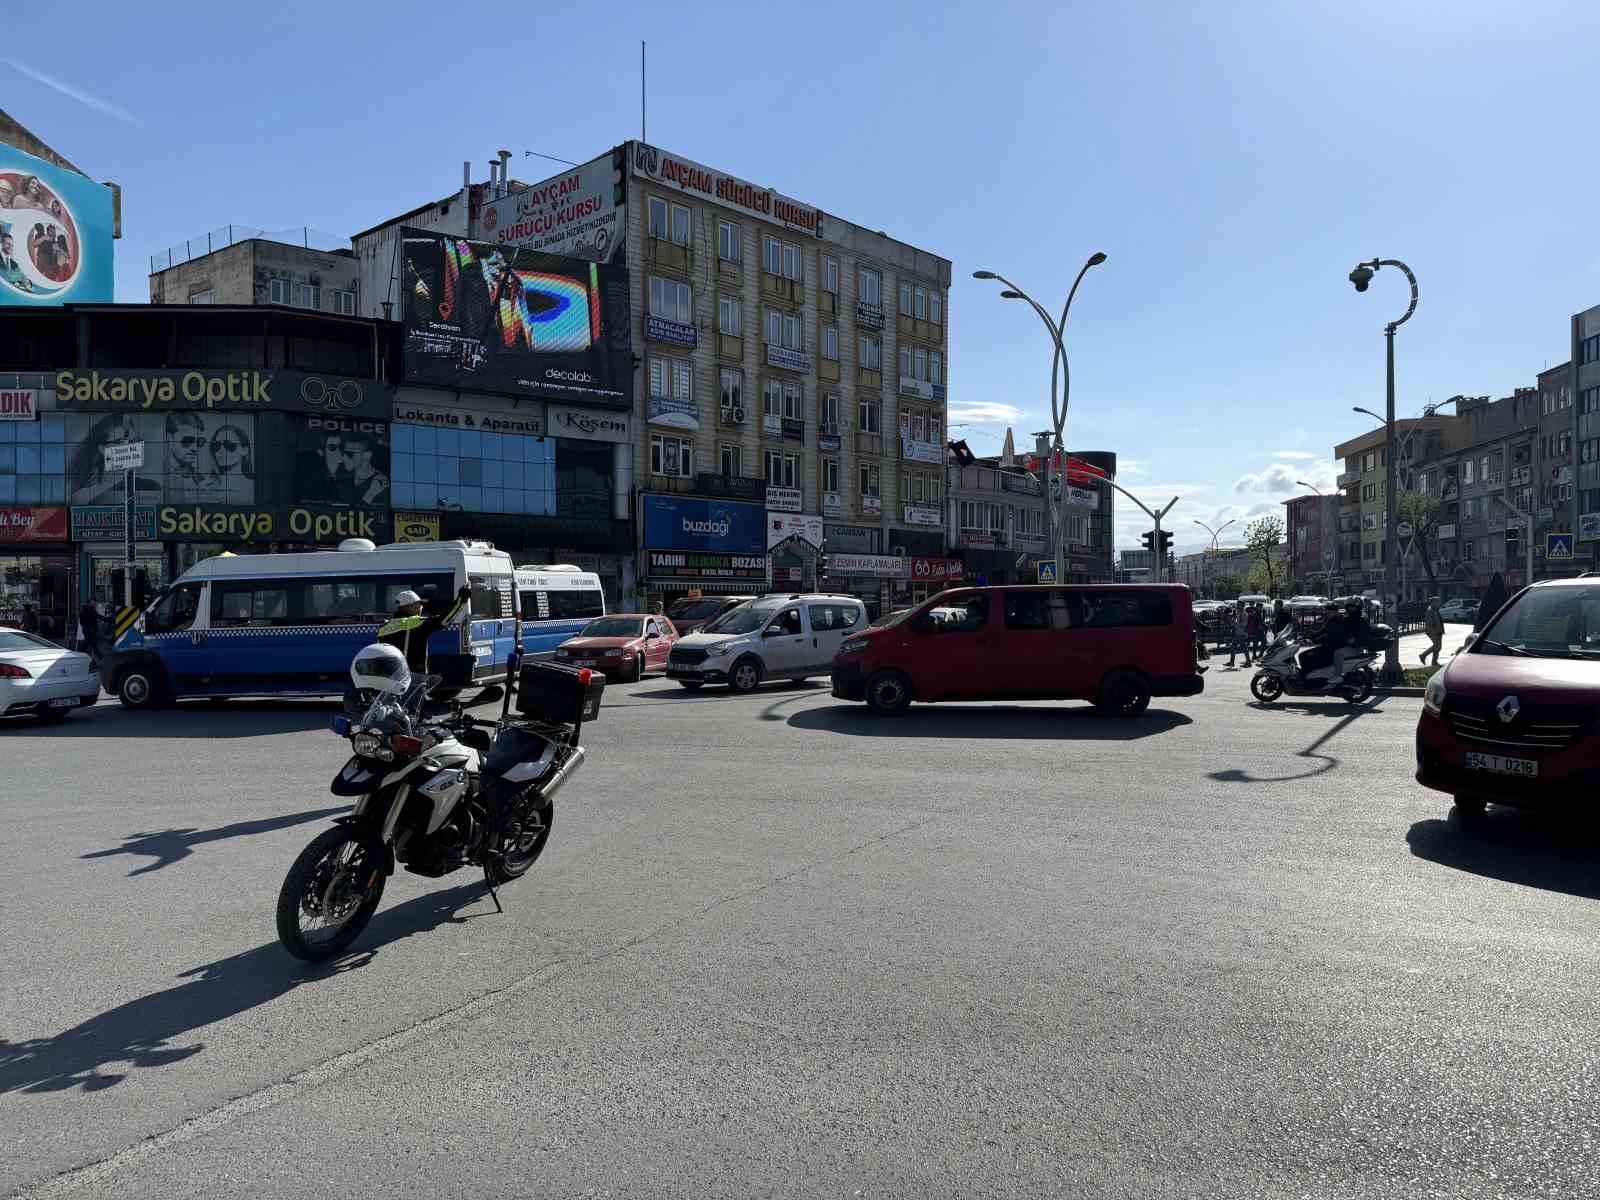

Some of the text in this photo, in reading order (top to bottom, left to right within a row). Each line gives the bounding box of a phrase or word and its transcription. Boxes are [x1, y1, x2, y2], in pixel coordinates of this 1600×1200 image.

[532, 174, 580, 207] AYÇAM
[661, 158, 817, 231] AYÇAM SÜRÜCÜ KURSU
[557, 194, 602, 225] KURSU
[56, 371, 272, 408] Sakarya Optik
[545, 368, 592, 382] decolab
[308, 418, 385, 433] POLICE
[395, 406, 458, 425] Lokanta
[464, 414, 474, 425] &
[160, 507, 376, 541] Sakarya Optik
[1471, 752, 1487, 767] 54
[1492, 756, 1499, 769] T
